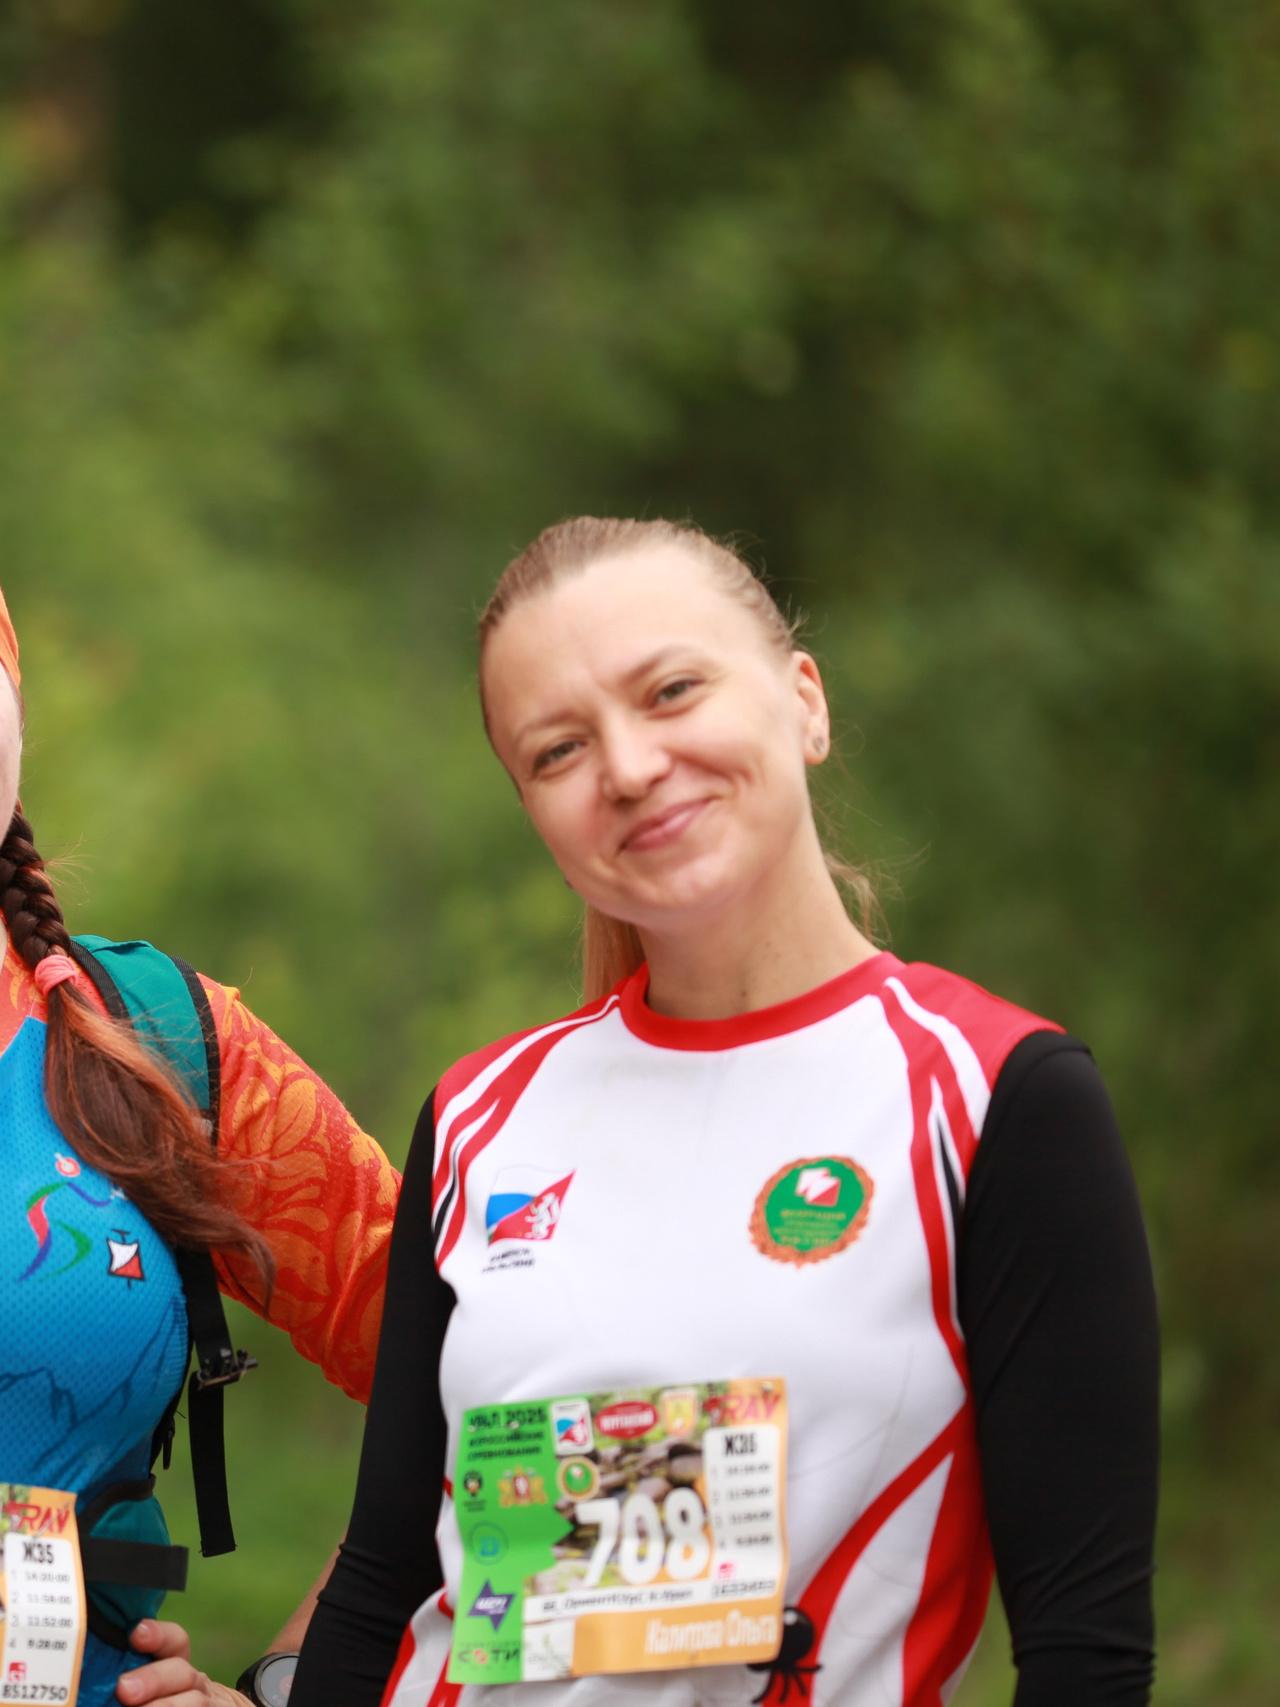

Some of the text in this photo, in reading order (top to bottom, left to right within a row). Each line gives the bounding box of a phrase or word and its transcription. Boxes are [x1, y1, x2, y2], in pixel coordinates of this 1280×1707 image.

[575, 1486, 711, 1587] 708
[22, 1541, 54, 1564] Ж35
[2, 1684, 68, 1702] 8512750
